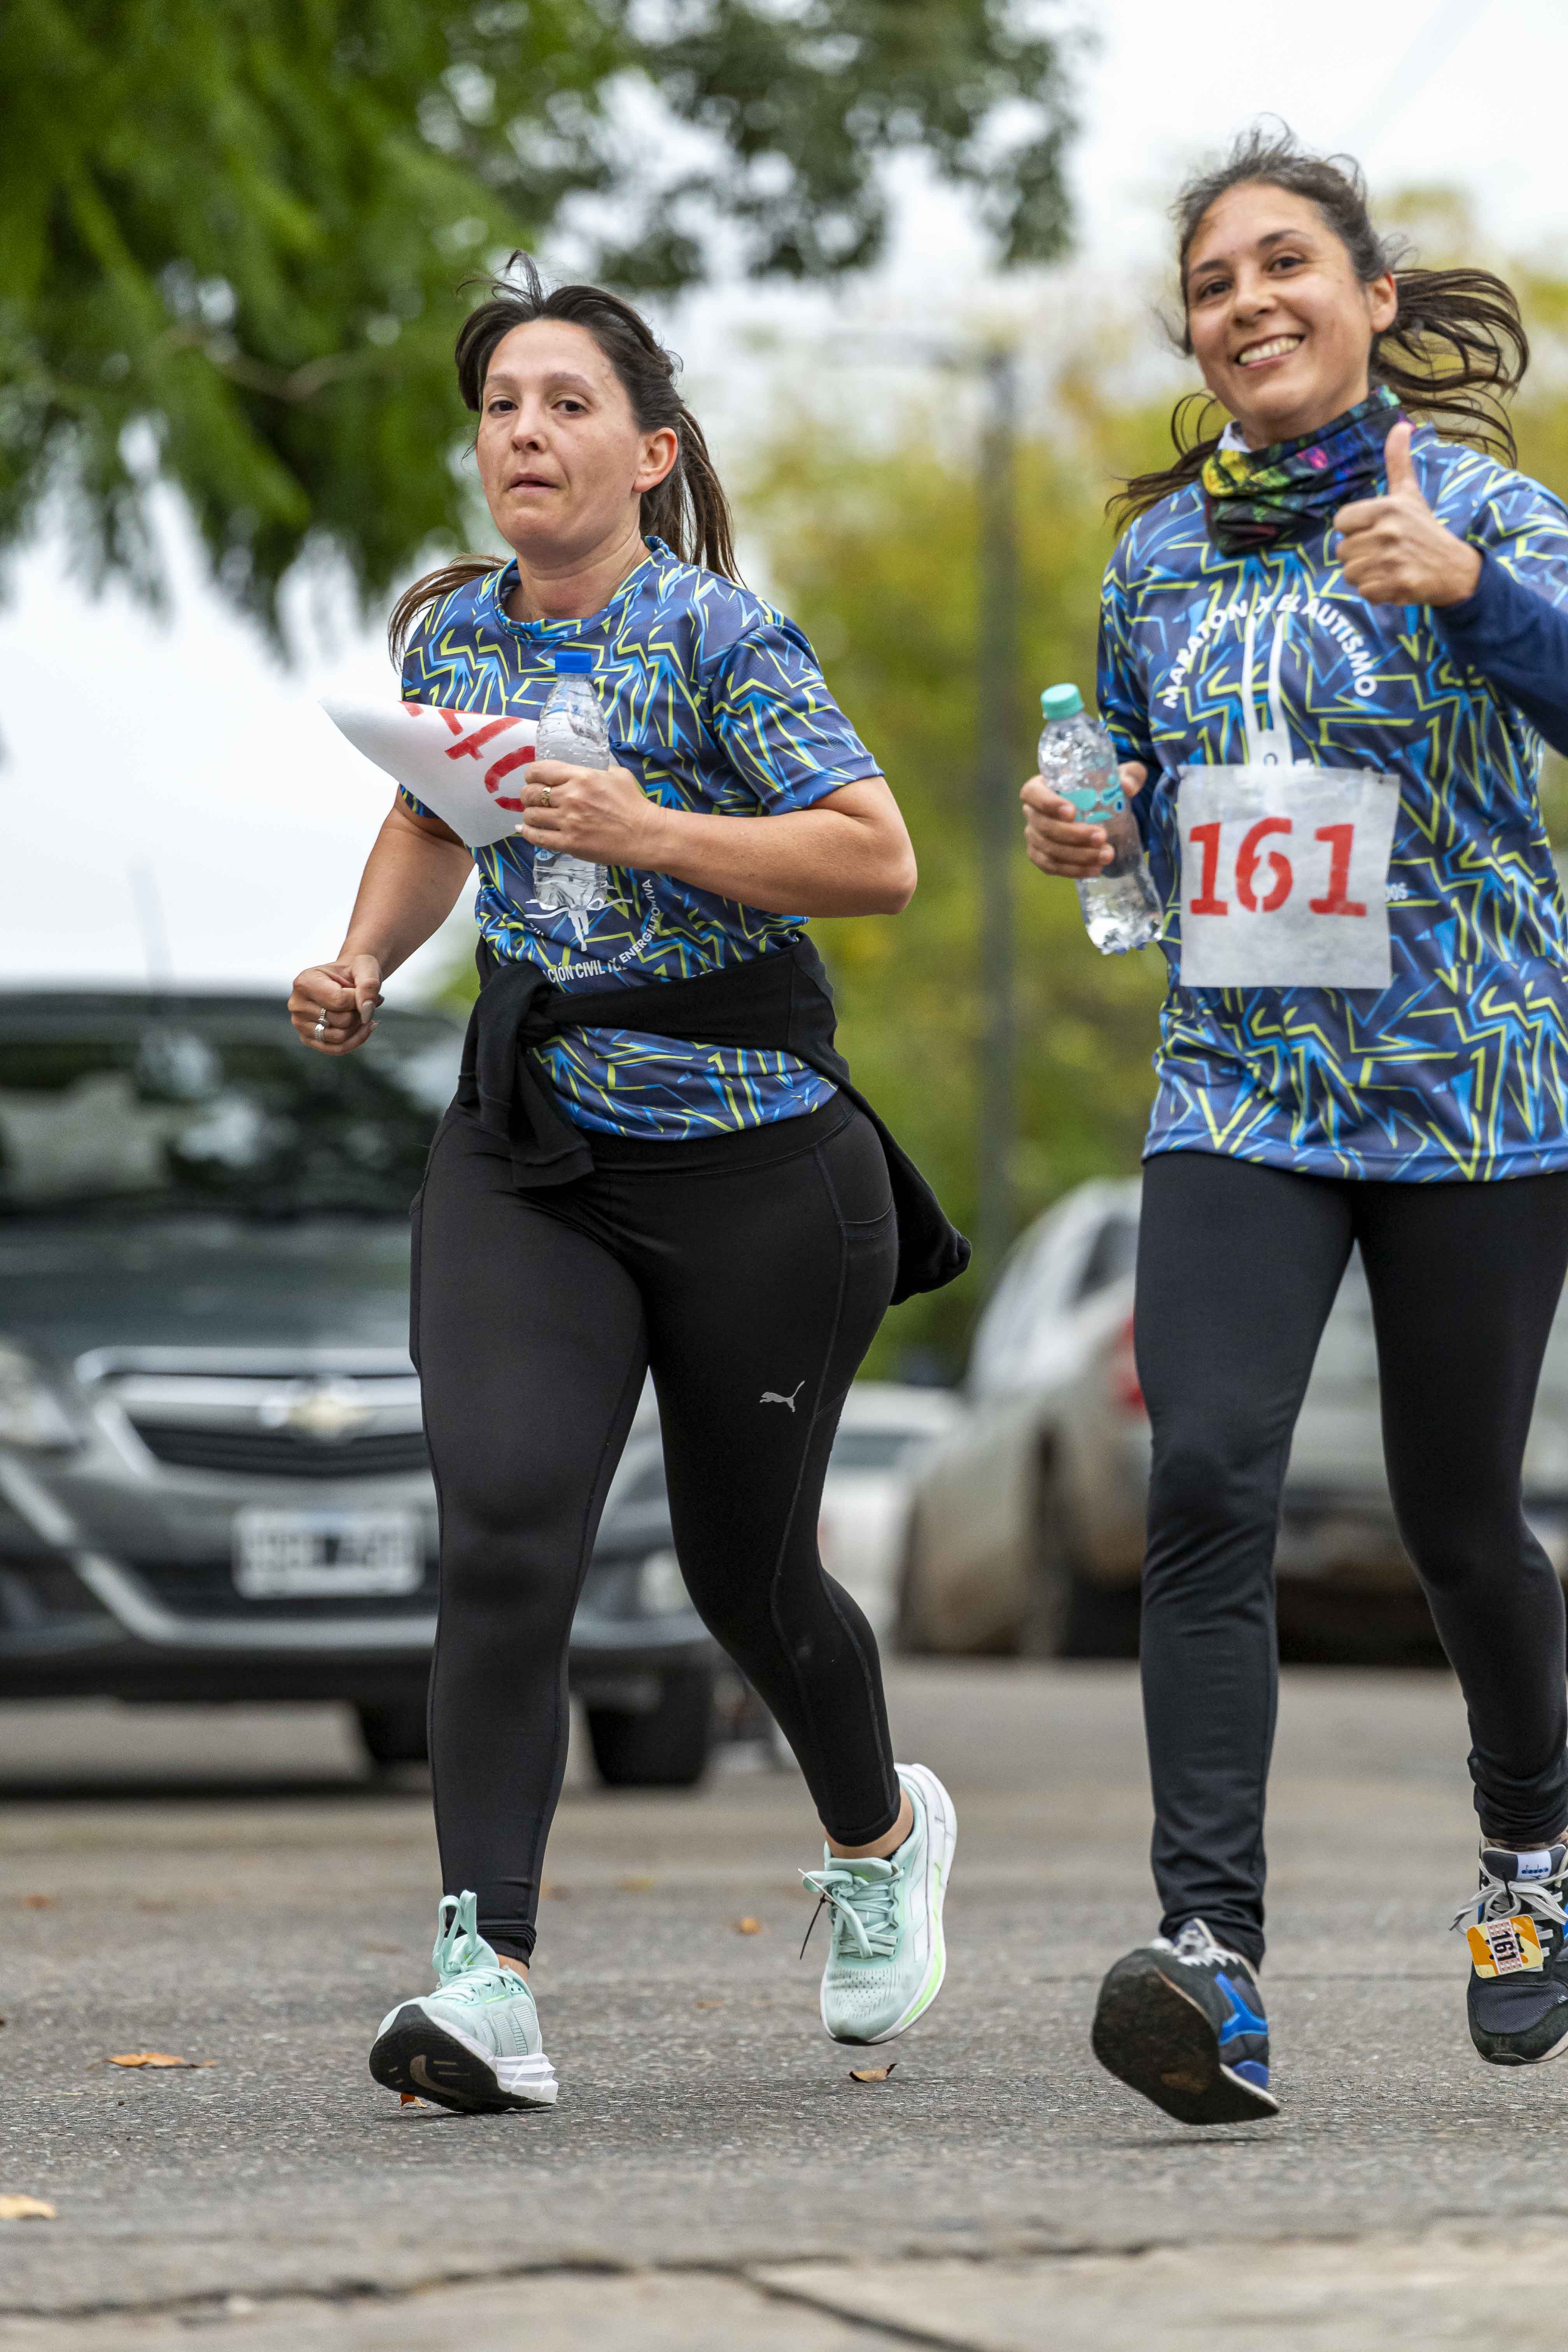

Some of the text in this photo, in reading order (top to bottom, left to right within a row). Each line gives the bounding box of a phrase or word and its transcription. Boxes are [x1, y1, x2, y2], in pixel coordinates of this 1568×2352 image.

[1254, 596, 1272, 613] X
[1277, 593, 1301, 613] EL
[1300, 598, 1377, 696] AUTISMO
[1189, 816, 1367, 917] 161
[575, 960, 606, 978] CIVIL
[1491, 1931, 1517, 1961] 161
